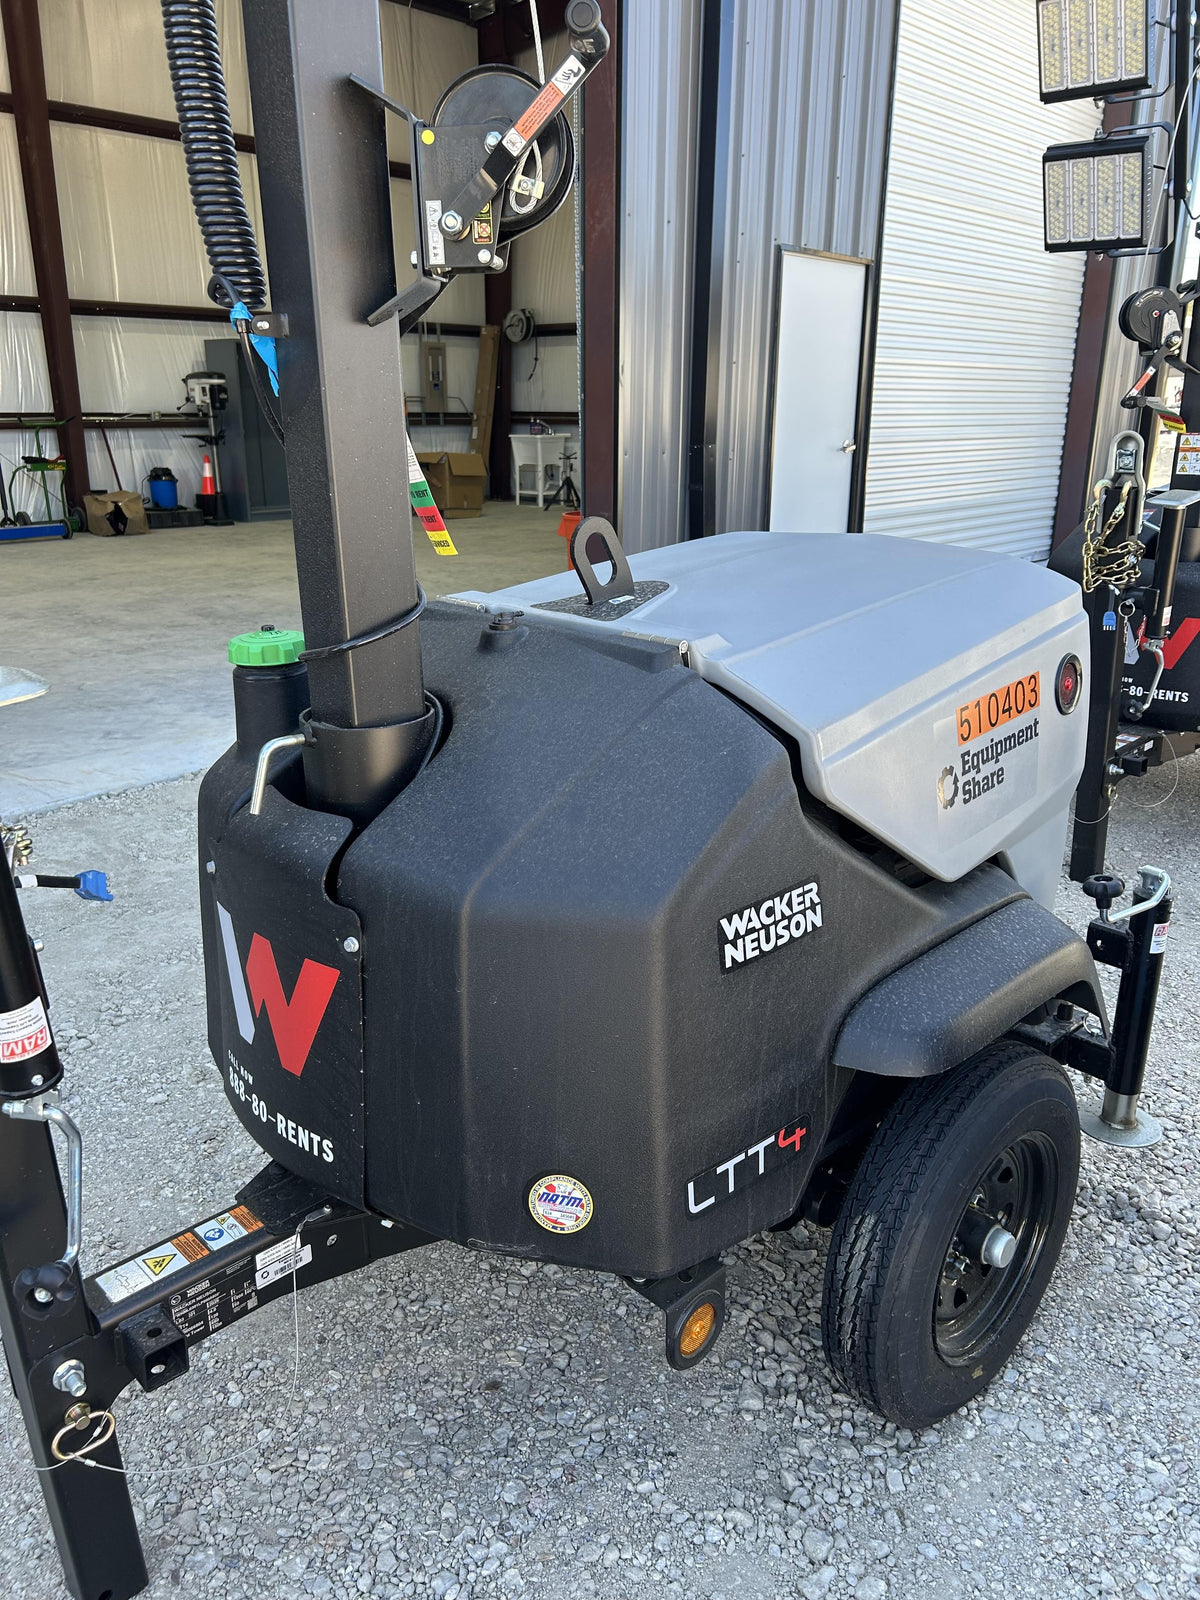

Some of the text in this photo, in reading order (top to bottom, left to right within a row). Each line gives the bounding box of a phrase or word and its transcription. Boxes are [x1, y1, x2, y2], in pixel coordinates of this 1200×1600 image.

[415, 489, 429, 498] RENT
[960, 674, 1038, 742] 510403
[961, 718, 1040, 777] Equipment
[962, 766, 1005, 805] Share
[720, 882, 821, 941] WACKER
[724, 904, 823, 969] NEUSON
[3, 1026, 48, 1057] RAM
[228, 1049, 253, 1085] CALL NOW
[229, 1065, 334, 1164] 888-80-RENTS
[688, 1127, 806, 1214] LTT4
